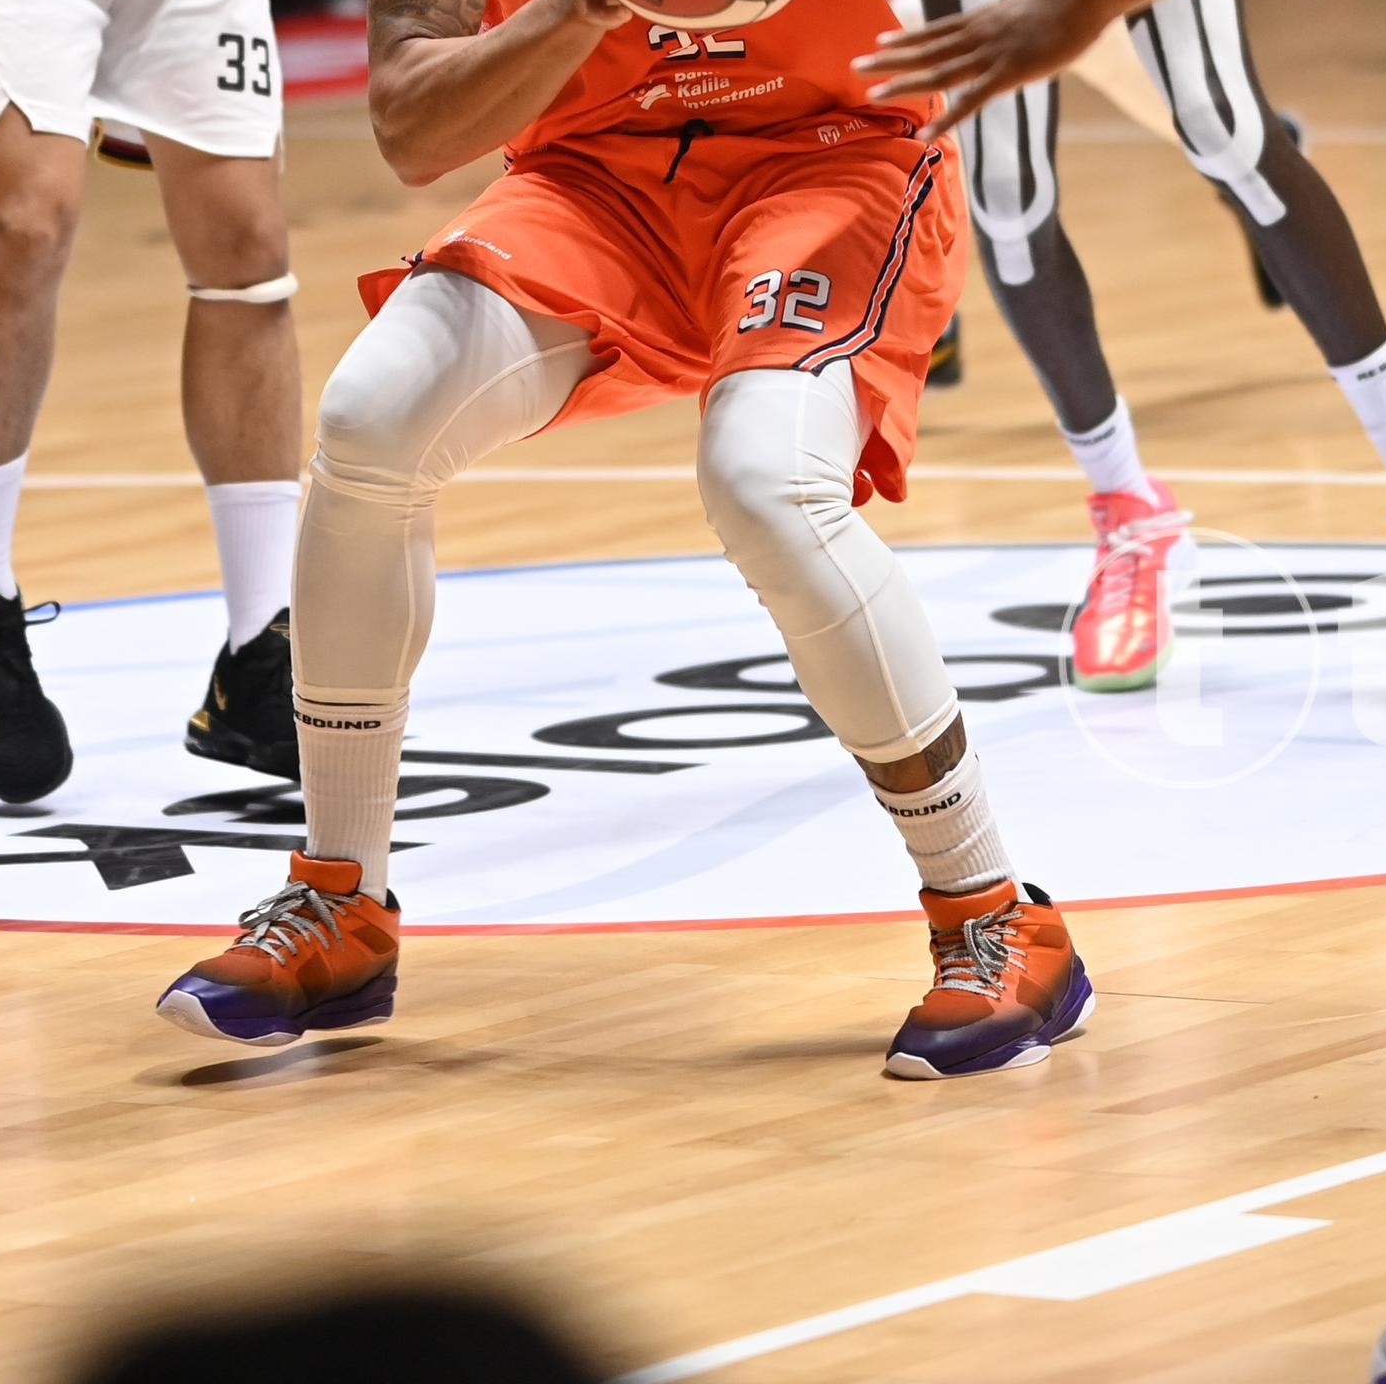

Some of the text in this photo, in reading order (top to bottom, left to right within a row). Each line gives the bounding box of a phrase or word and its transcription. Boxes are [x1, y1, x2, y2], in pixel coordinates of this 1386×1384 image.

[217, 33, 273, 98] 33
[677, 77, 731, 99] Kalila
[683, 75, 785, 110] Investment
[843, 118, 870, 133] MIL
[738, 268, 832, 334] 32
[293, 710, 382, 730] EBOUND
[875, 791, 962, 818] BOUND
